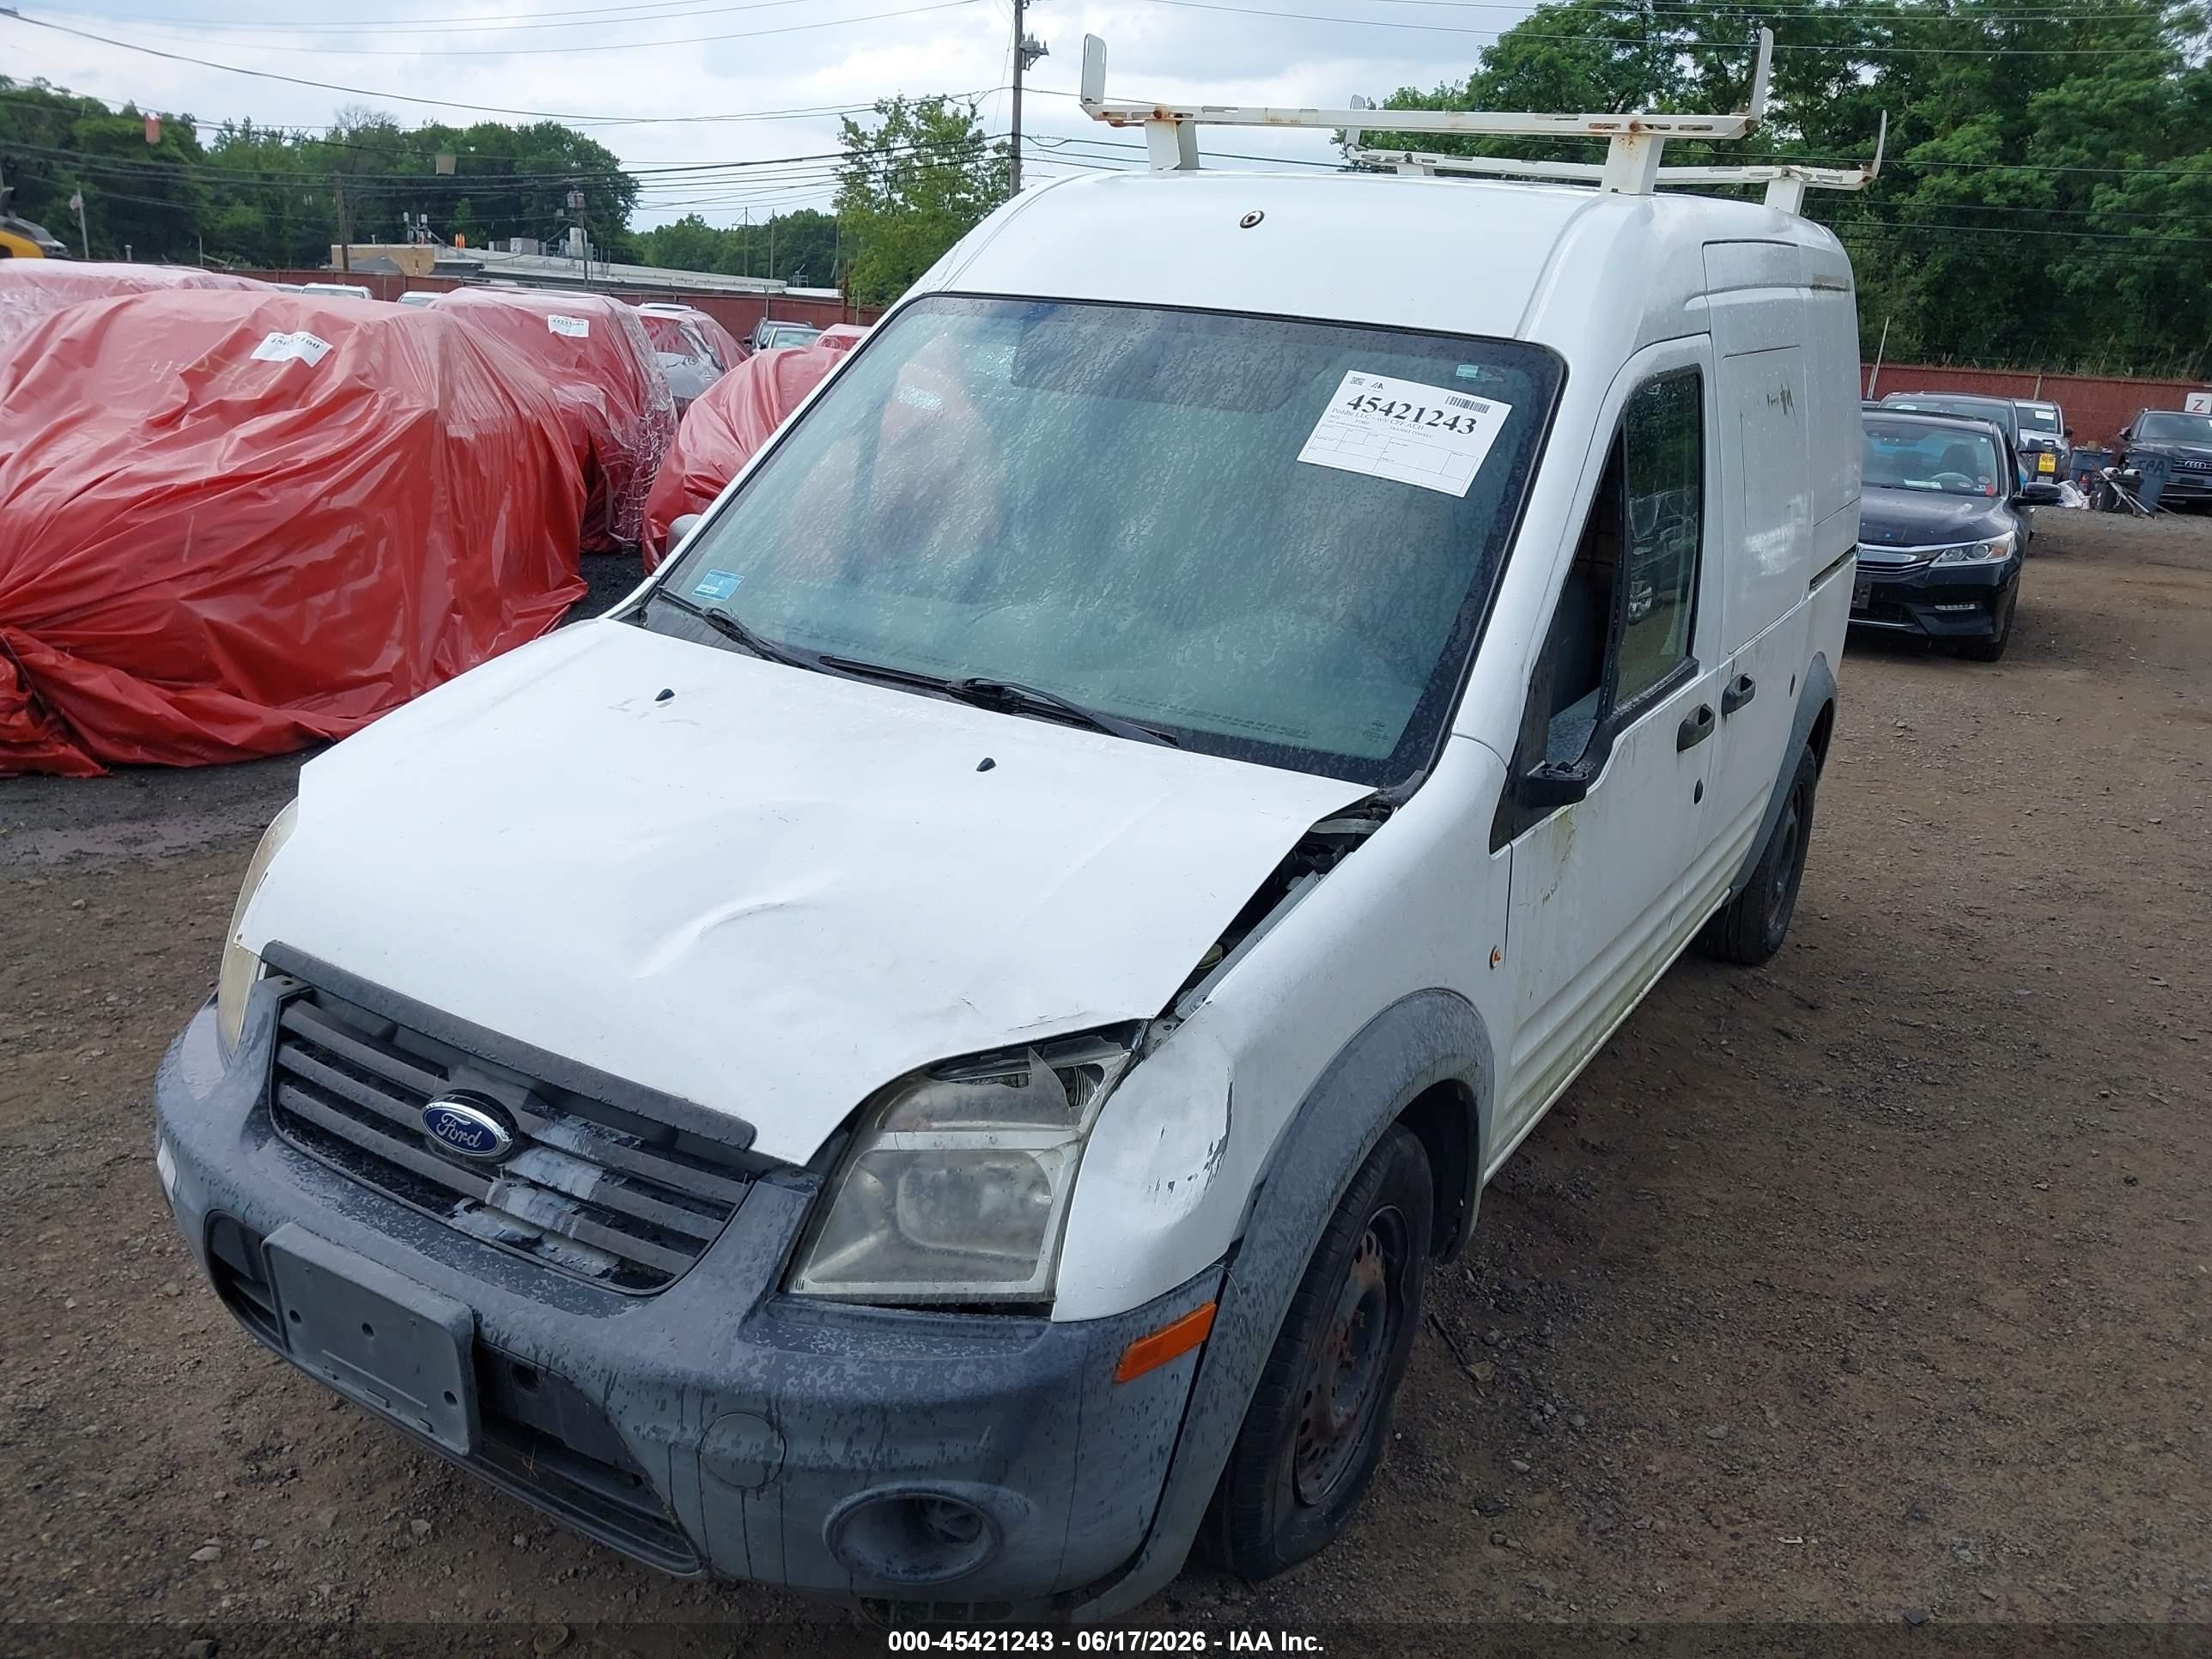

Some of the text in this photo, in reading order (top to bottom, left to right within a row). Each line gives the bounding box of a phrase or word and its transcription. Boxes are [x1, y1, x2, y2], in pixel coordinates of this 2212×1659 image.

[1346, 394, 1477, 434] 45421243
[2192, 399, 2204, 411] Z
[436, 1113, 483, 1148] Ford
